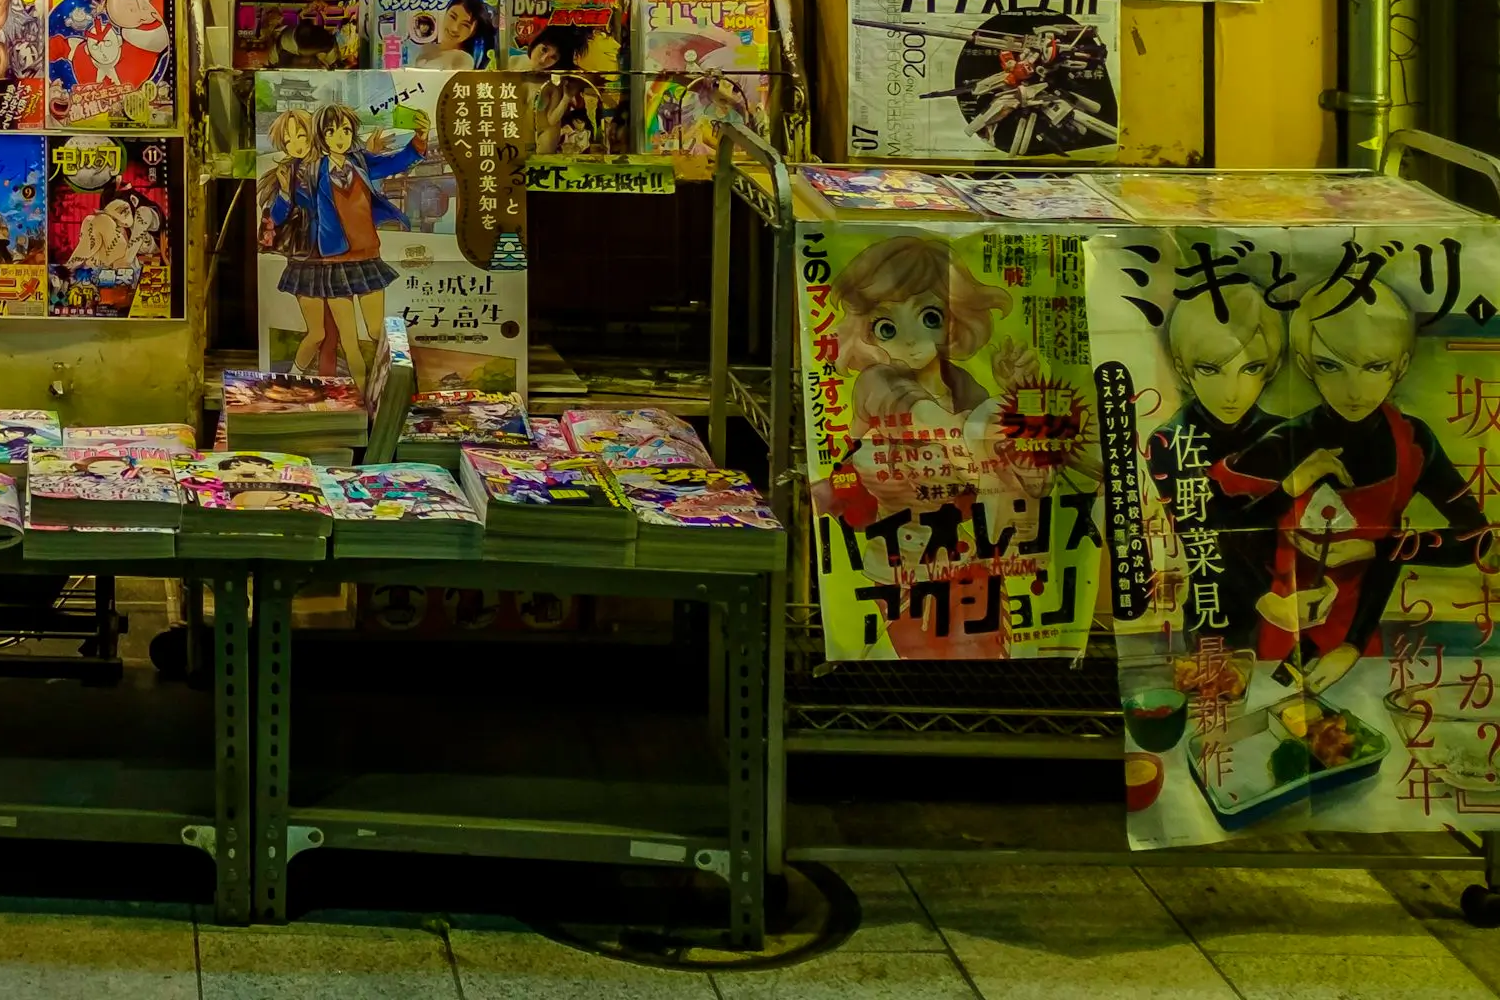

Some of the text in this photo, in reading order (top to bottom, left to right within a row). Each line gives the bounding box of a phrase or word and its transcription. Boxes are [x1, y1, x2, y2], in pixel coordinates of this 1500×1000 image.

[724, 16, 766, 29] MOMO
[452, 82, 472, 160] 知る旅へ。
[851, 124, 879, 152] 07
[147, 148, 158, 161] 11
[476, 82, 498, 231] 数百年前の英知を
[25, 188, 32, 199] 9
[406, 274, 498, 297] 東京城址
[1120, 237, 1463, 327] ミギとダリ
[397, 304, 503, 328] 女子高生
